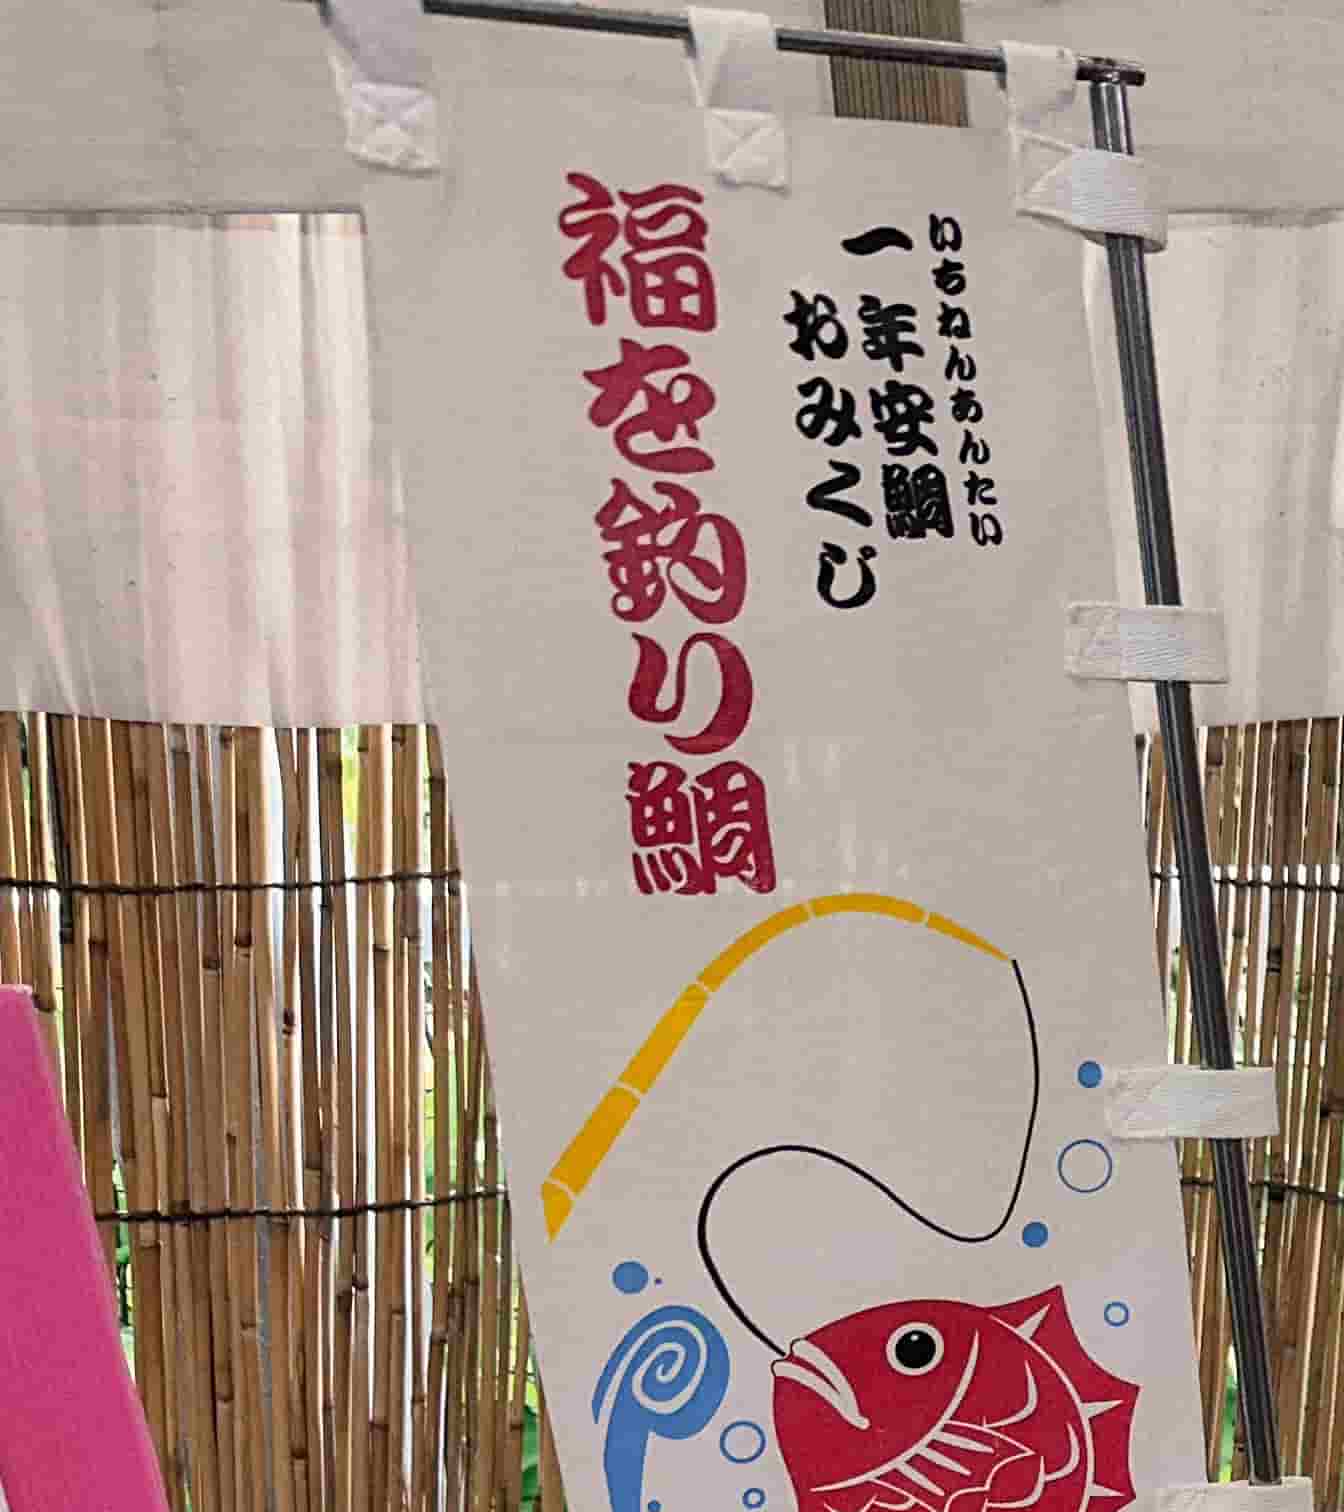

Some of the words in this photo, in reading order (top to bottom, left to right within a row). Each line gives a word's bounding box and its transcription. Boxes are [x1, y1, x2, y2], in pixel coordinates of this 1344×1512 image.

[557, 172, 777, 894] 福を釣り鯛
[783, 290, 877, 608] おみくじ
[841, 226, 954, 538] 一年安鯛
[929, 213, 1003, 546] いちねんあんたい
